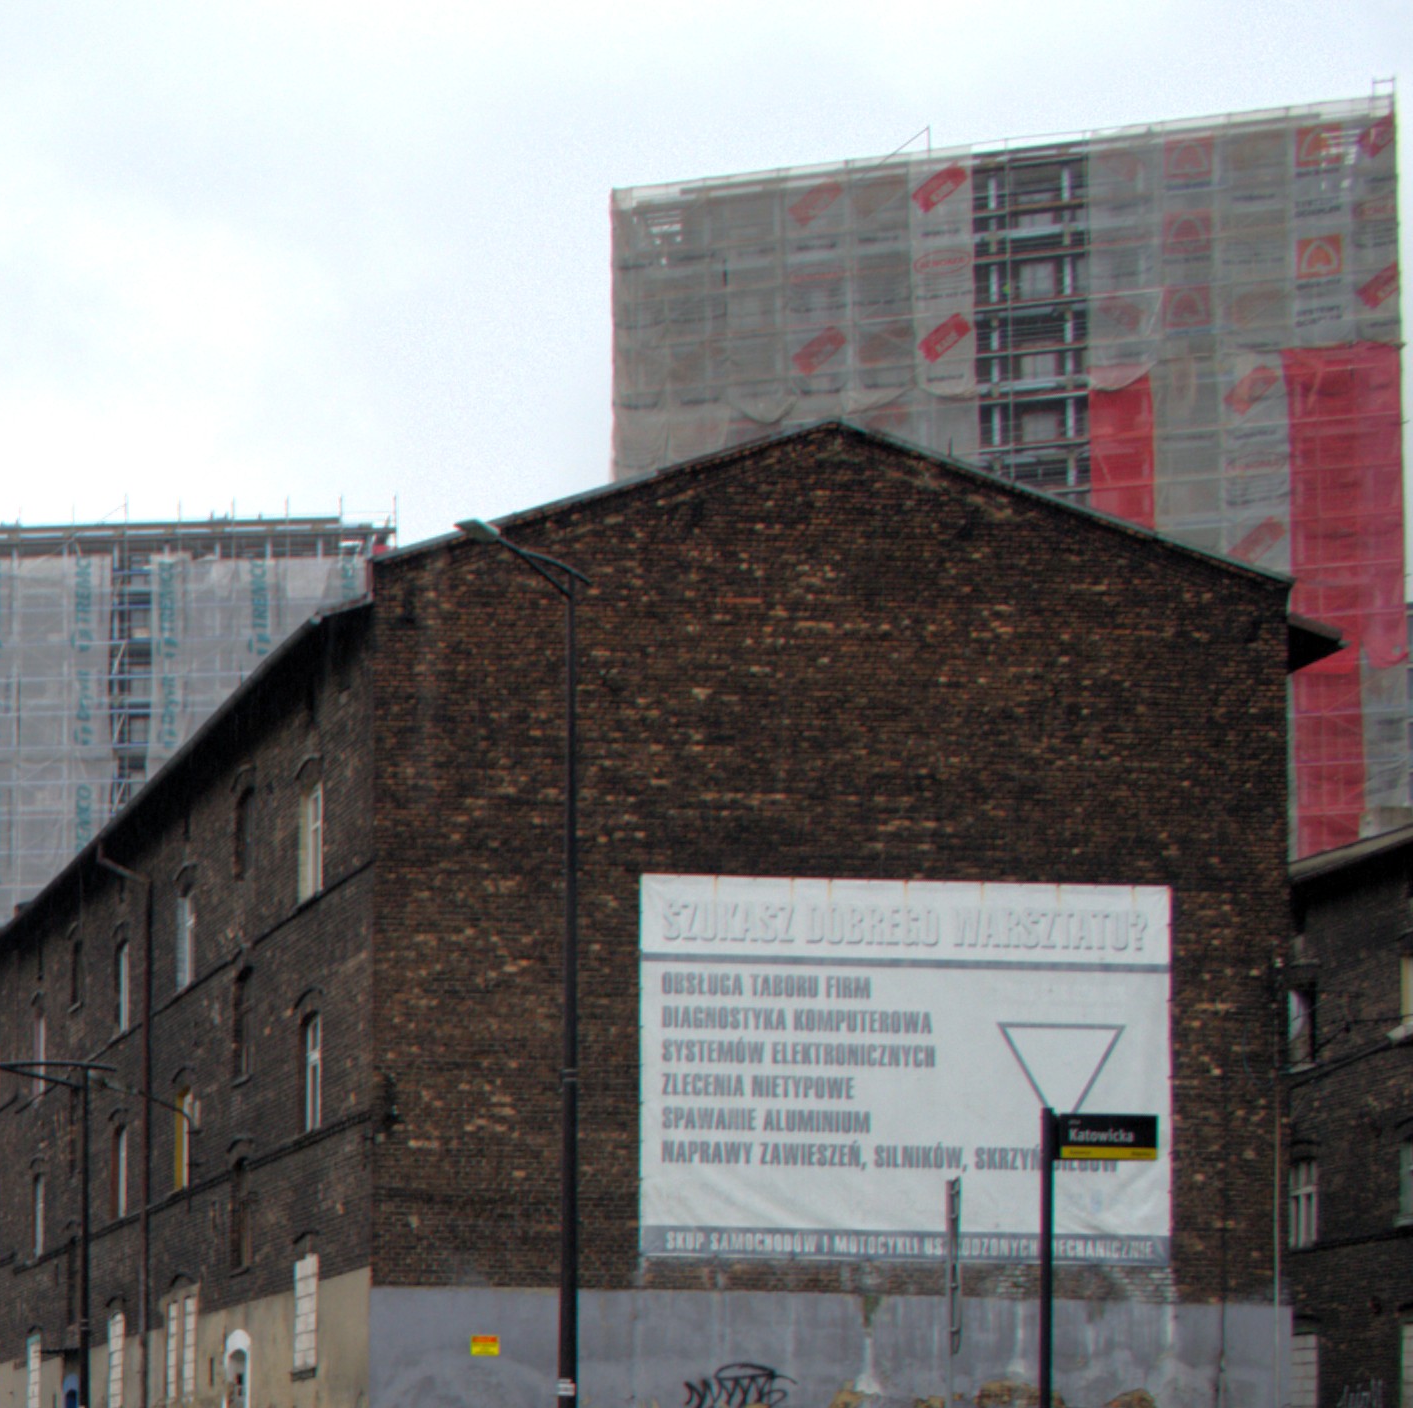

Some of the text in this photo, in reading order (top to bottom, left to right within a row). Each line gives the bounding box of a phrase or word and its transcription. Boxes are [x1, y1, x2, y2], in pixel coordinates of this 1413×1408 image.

[662, 901, 1148, 951] SZUKASZ DOBREGO WARSZTATU?
[661, 971, 872, 1000] OBSŁUGA TABORU FIRM
[661, 1005, 933, 1035] DIAGNOSTYKA KOMPUTEROWA
[661, 1036, 936, 1068] SYSTEMÓW ELEKTRONICZNYCH
[661, 1072, 855, 1100] ZLECENIA NIETYPOWE
[661, 1105, 871, 1134] SPAWANIE ALUMINIUM
[1069, 1128, 1135, 1143] Katowicka
[661, 1139, 754, 1165] NAPRAWY
[759, 1140, 867, 1171] ZAWIESZEŃ,
[874, 1142, 968, 1173] SILNIKÓW,
[665, 1230, 705, 1250] SKUP
[710, 1230, 818, 1252] SAMOCHODÓW
[833, 1235, 918, 1255] MOTOCYKLI
[923, 1236, 1039, 1256] USODZONYCH
